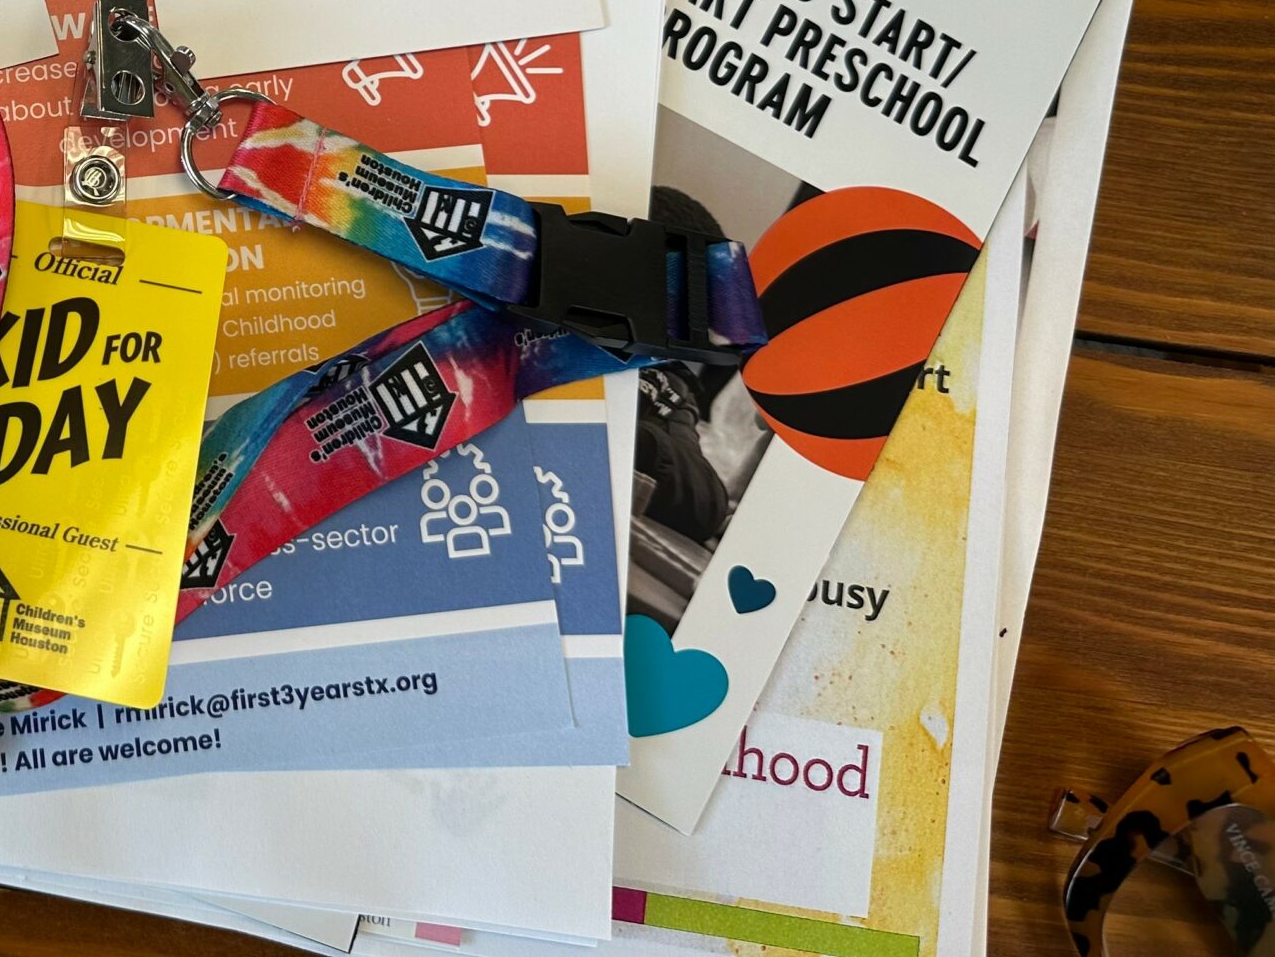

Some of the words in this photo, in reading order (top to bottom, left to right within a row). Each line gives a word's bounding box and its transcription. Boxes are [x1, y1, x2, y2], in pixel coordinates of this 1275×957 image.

[662, 7, 832, 139] ROGRAM
[760, 3, 986, 168] PRESCHOOL
[33, 252, 124, 286] Official
[245, 277, 366, 303] monitoring
[223, 310, 337, 338] Childhood
[102, 331, 163, 366] FOR
[229, 343, 320, 369] referrals
[63, 526, 120, 553] Guest
[15, 603, 86, 629] Children's
[13, 618, 72, 642] Museum
[10, 633, 69, 655] Houston
[10, 712, 87, 737] Mirick
[15, 748, 46, 773] All
[51, 746, 94, 767] are
[99, 728, 223, 763] welcome!
